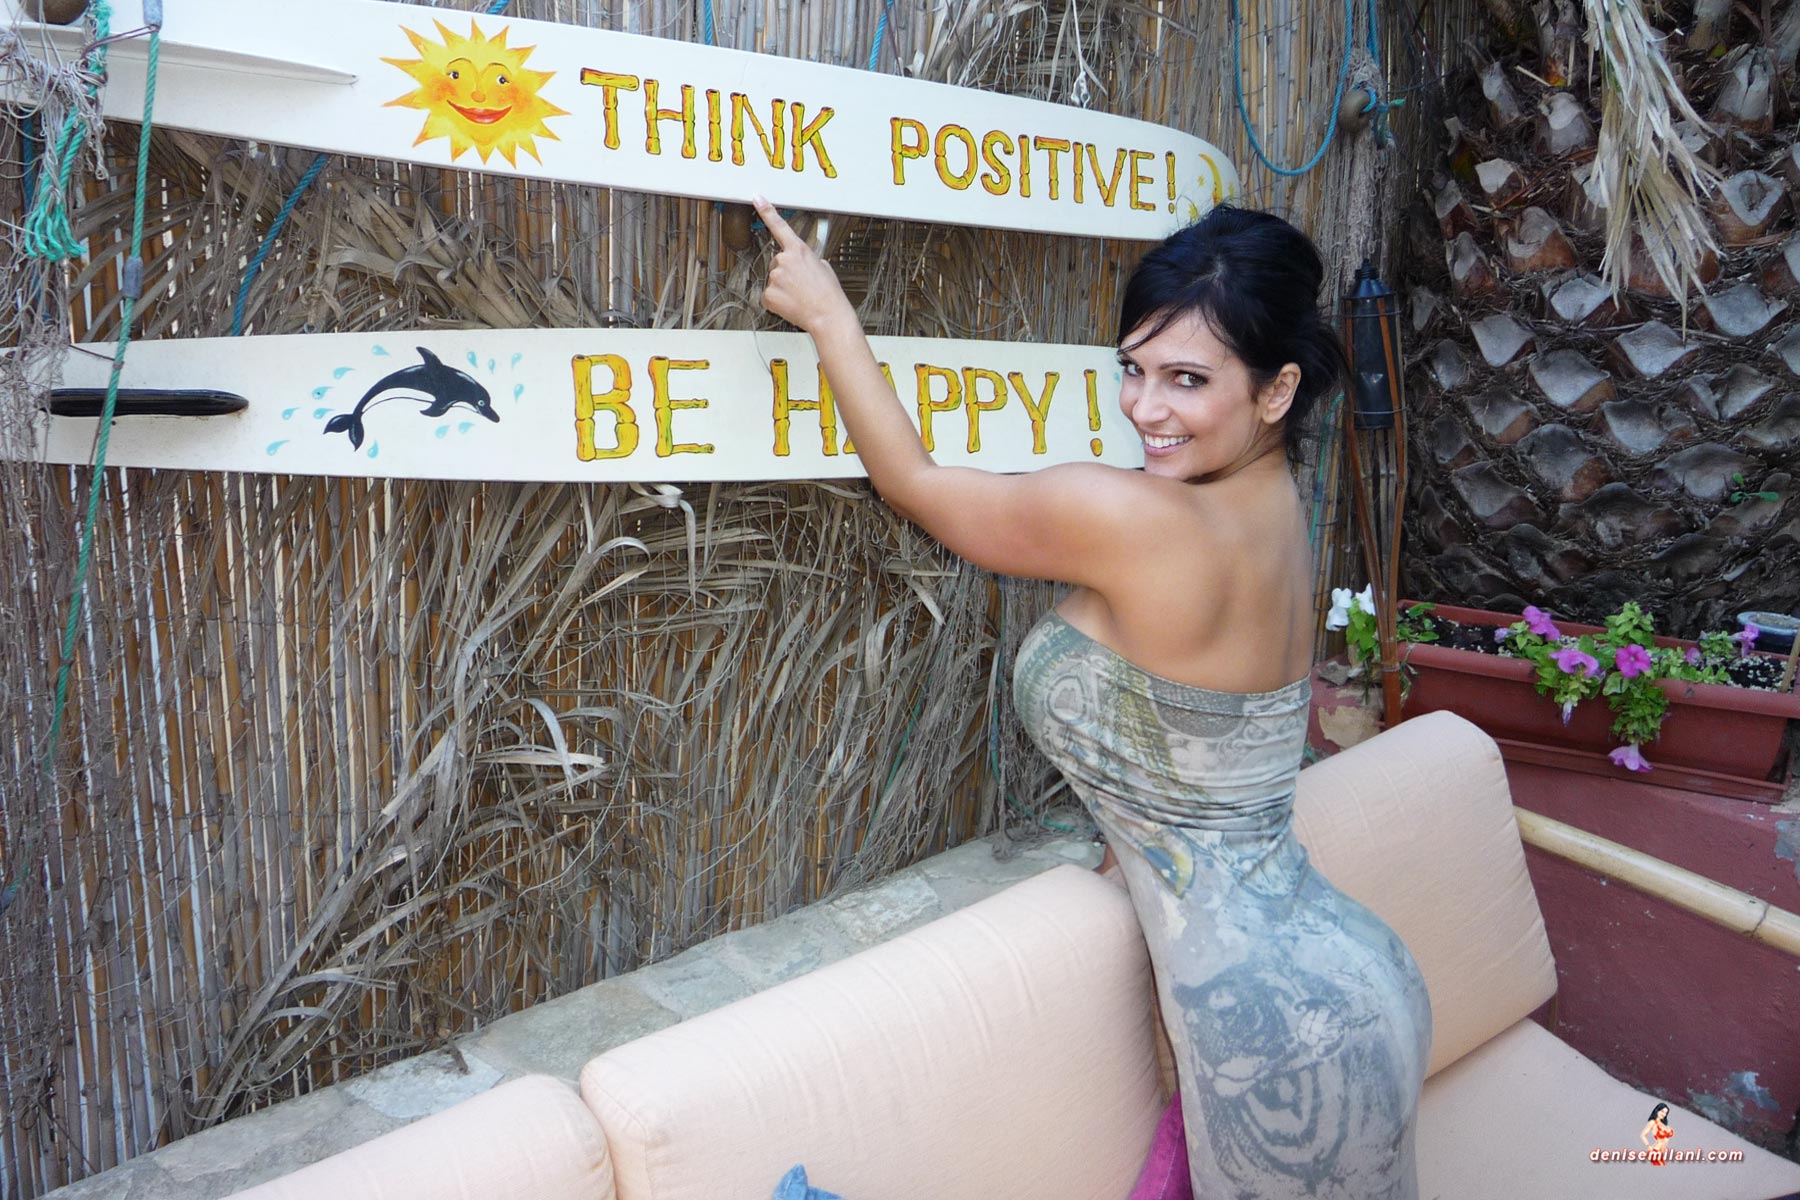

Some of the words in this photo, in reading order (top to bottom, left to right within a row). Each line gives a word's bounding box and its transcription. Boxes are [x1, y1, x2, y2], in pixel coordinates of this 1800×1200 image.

[580, 68, 838, 179] THINK
[890, 116, 1177, 214] POSITIVE!
[571, 354, 716, 461] BE
